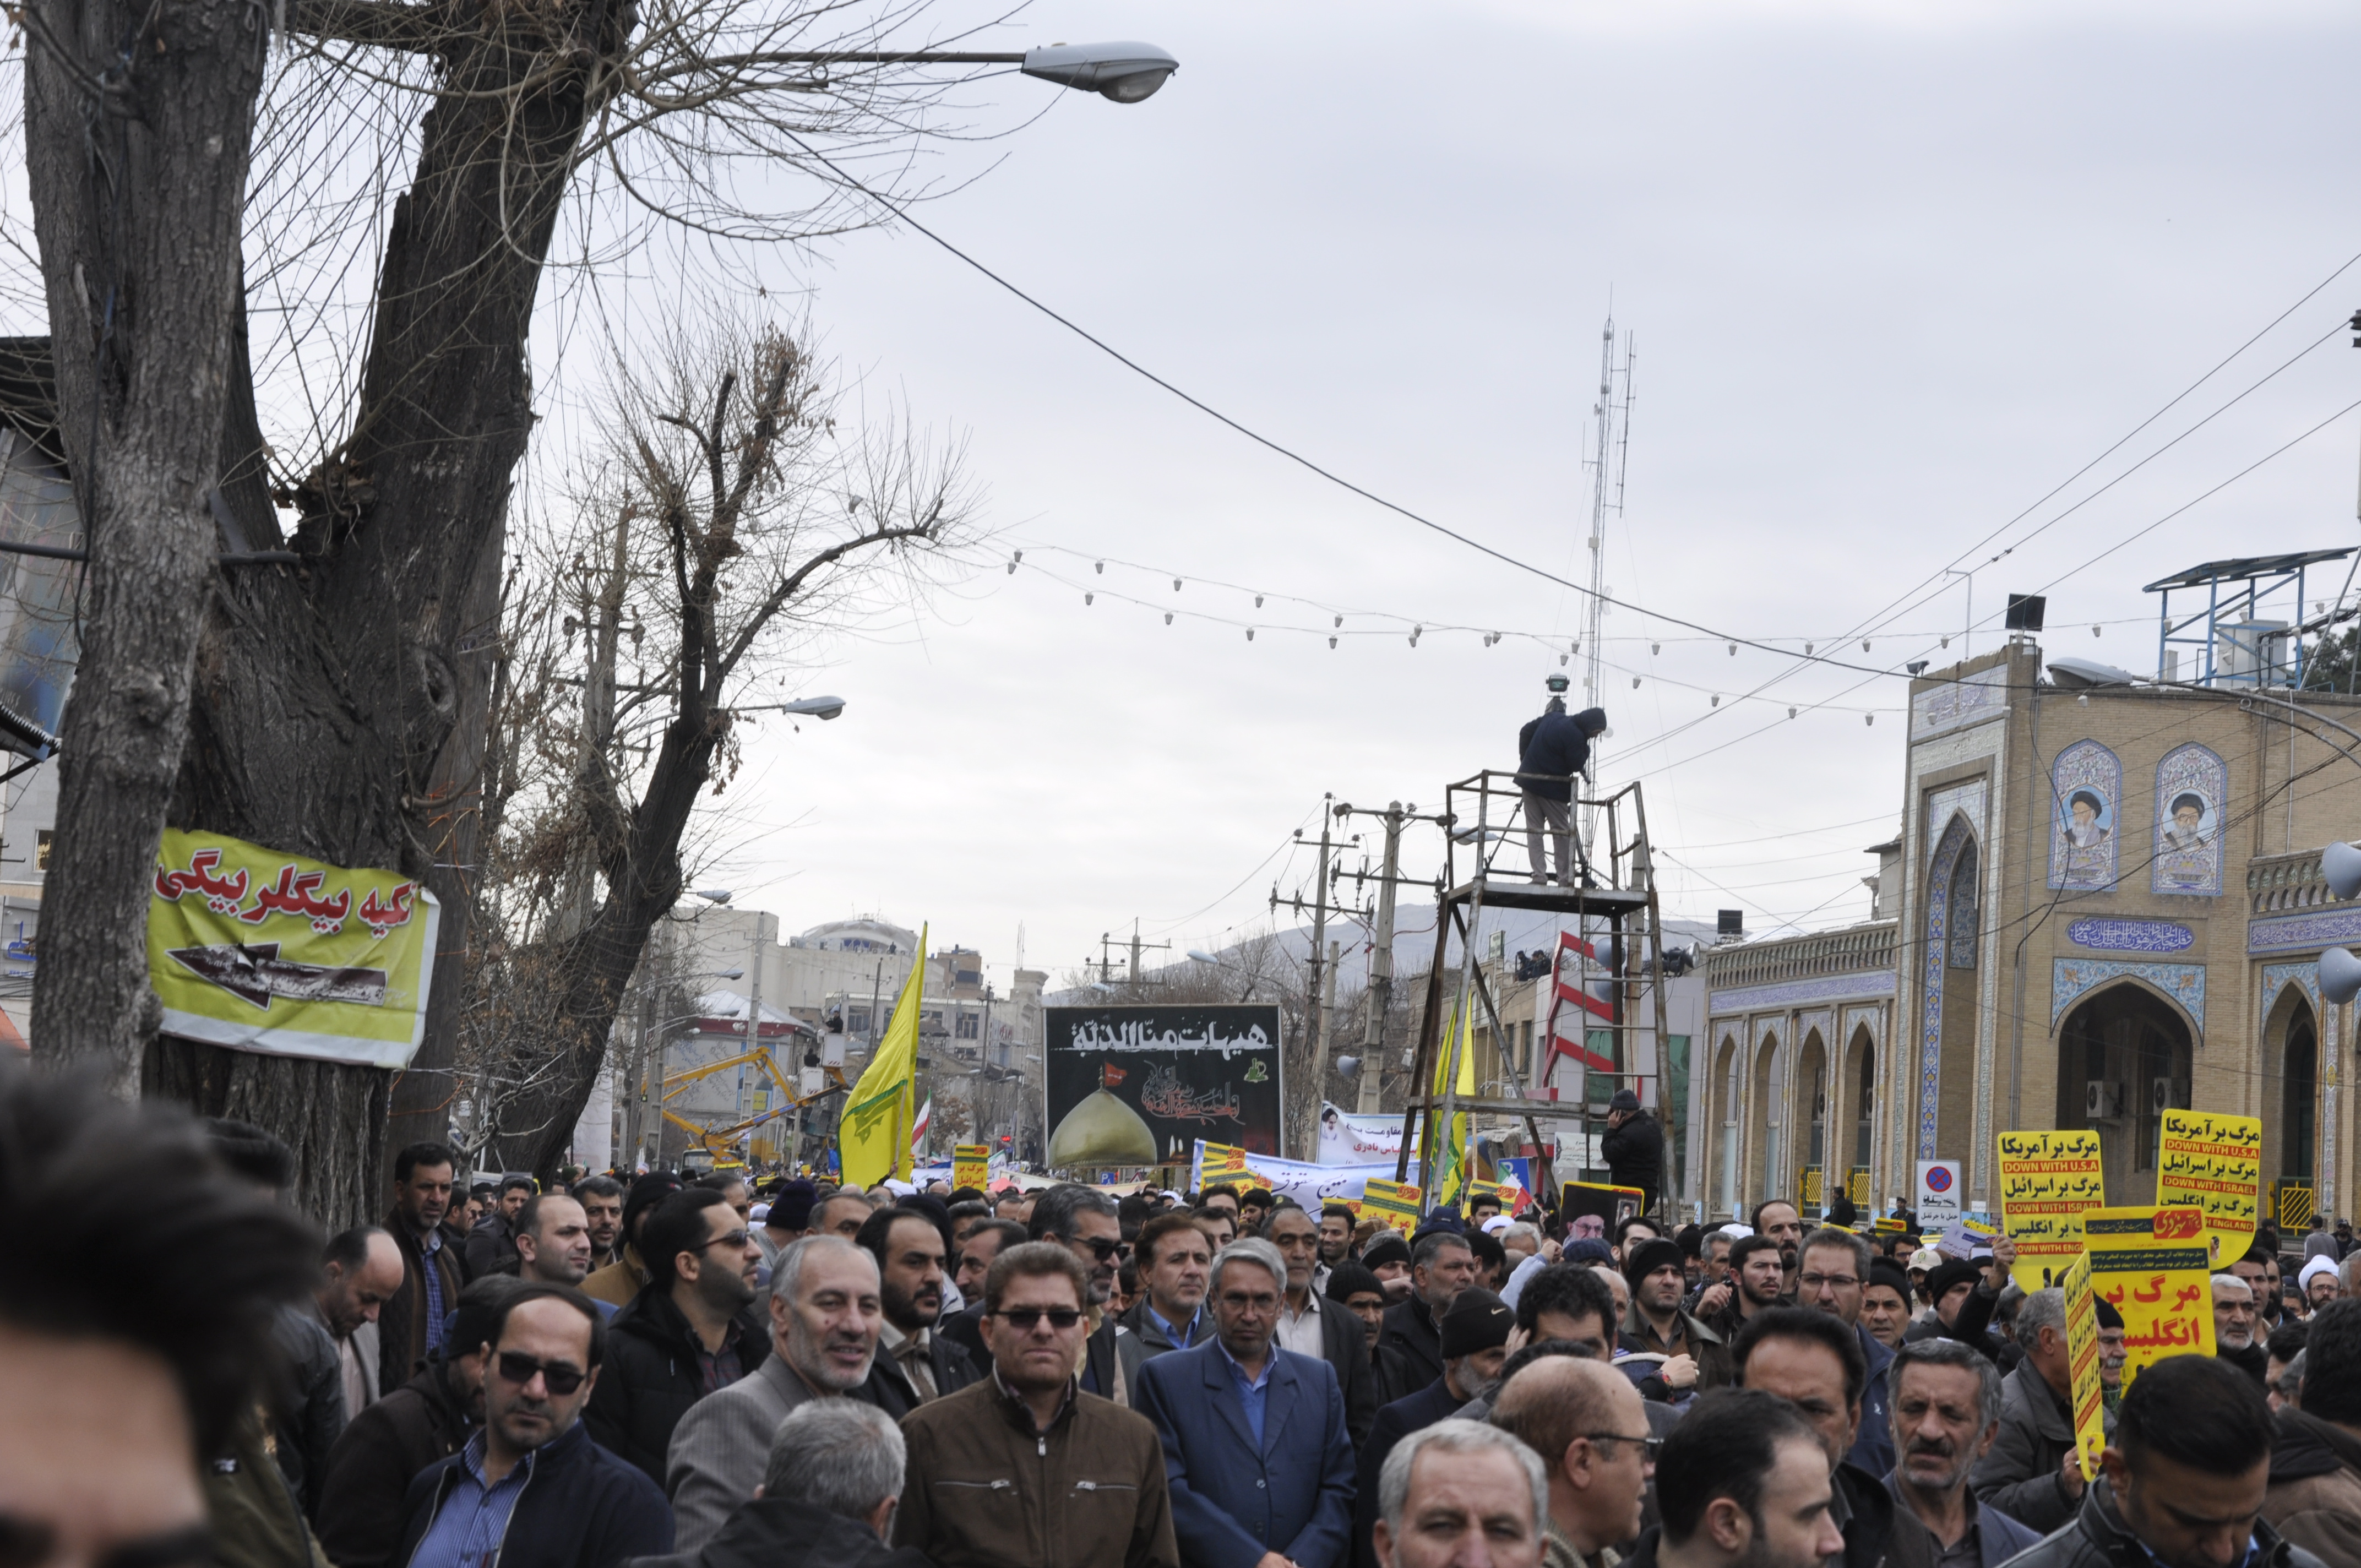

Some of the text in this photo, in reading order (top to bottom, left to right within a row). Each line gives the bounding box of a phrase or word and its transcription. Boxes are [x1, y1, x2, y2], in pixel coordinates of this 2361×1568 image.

[358, 879, 417, 939] تکیه
[1364, 1126, 1402, 1138] مقاومت
[2166, 1117, 2260, 1145] مرگ بر آمریکا
[1353, 1142, 1378, 1153] نادری
[2001, 1134, 2098, 1160] مرگ بر آمریکا
[2167, 1140, 2257, 1158] DOWN WITH U.S.A
[958, 1163, 984, 1174] مرگ بر
[2004, 1161, 2097, 1172] DOWN WITH U.S.A
[2163, 1153, 2257, 1180] مرگ بر اسرائیل
[956, 1174, 983, 1186] اسرائیل
[1102, 1174, 1108, 1183] P
[2164, 1177, 2255, 1195] DOWN WITH ISRAEL
[2005, 1176, 2101, 1198] مرگ بر اسرائیل
[2008, 1204, 2039, 1213] DOWN
[2041, 1202, 2065, 1212] WITH
[2208, 1201, 2221, 1213] بر
[2224, 1199, 2255, 1217] مرگ
[1921, 1211, 1958, 1221] حمل با جرثقیل
[2008, 1219, 2053, 1239] انگلیس
[2057, 1223, 2069, 1238] بر
[2213, 1218, 2253, 1231] ENGLAND
[2041, 1244, 2061, 1253] WITH
[2082, 1260, 2091, 1288] مرگ
[2134, 1273, 2201, 1311] مرگ
